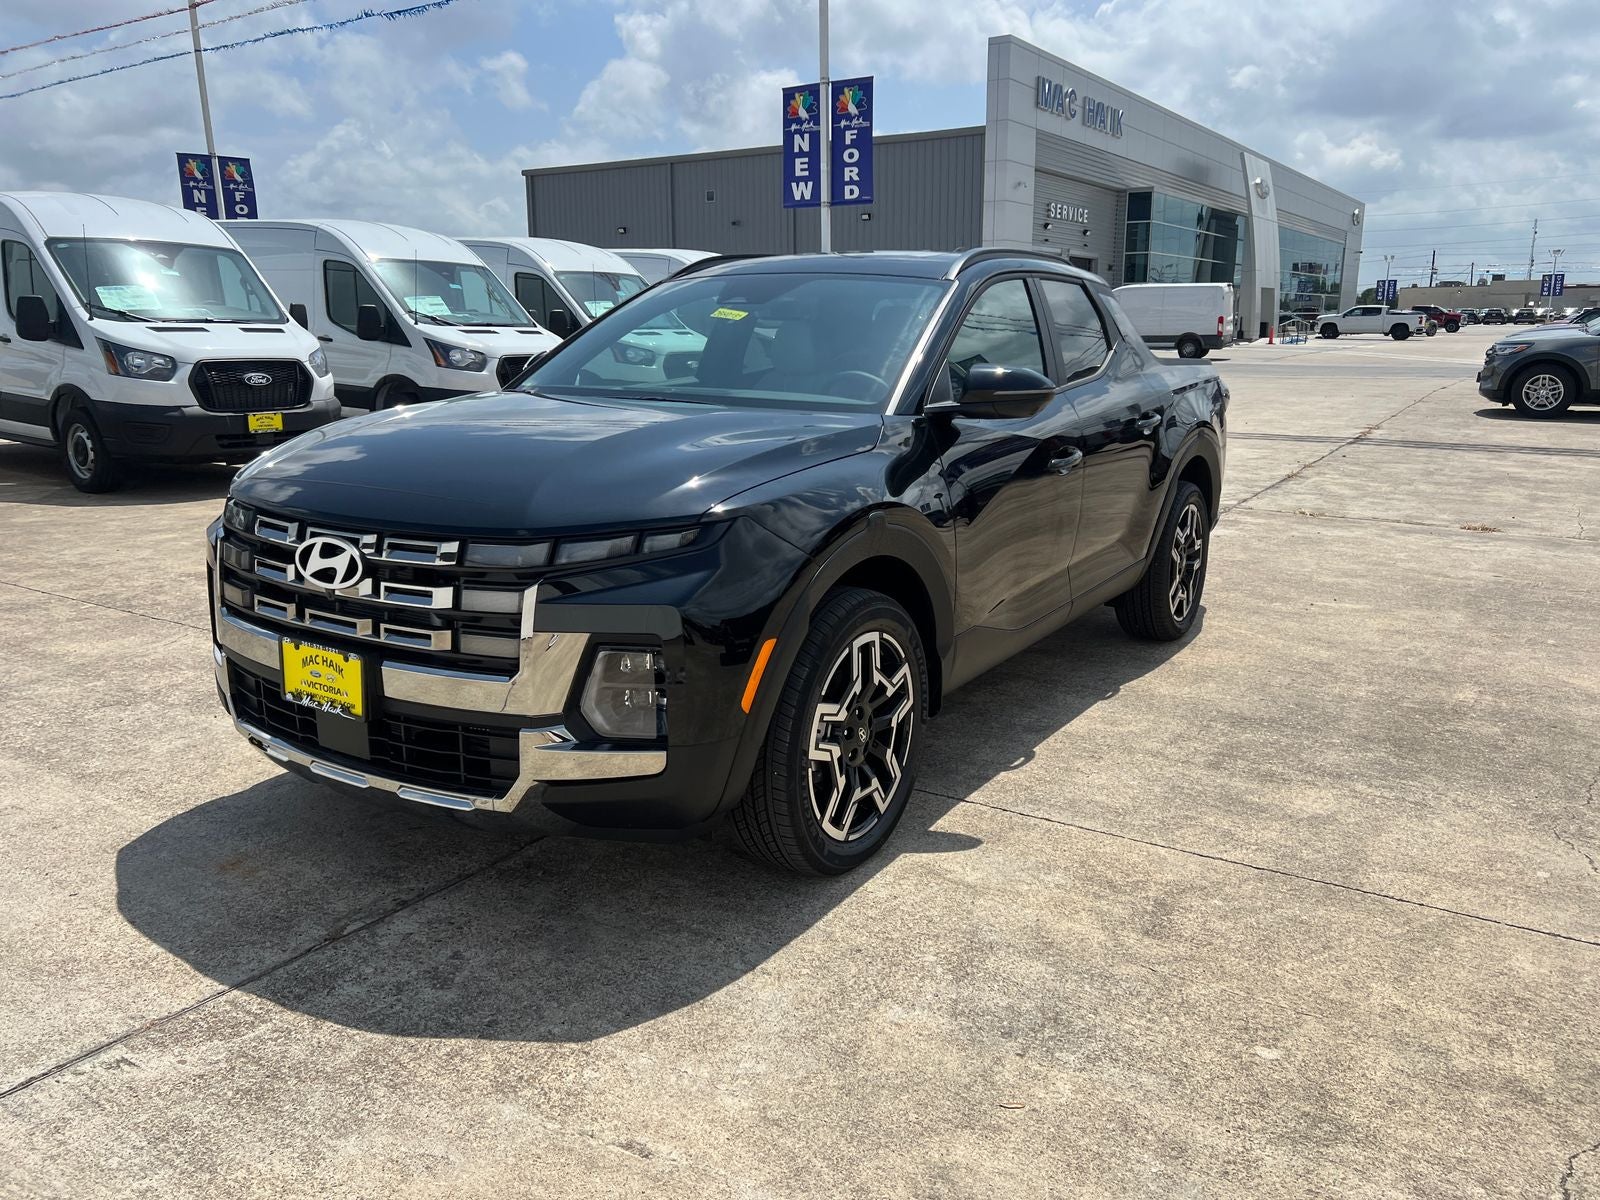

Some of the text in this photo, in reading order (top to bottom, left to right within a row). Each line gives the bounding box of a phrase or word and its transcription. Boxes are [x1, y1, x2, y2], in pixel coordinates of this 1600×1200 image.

[1036, 76, 1124, 139] MAC HAIK
[791, 133, 813, 201] NEW
[842, 129, 860, 200] FORD
[235, 192, 249, 219] FO
[1050, 202, 1088, 223] SERVICE
[302, 655, 344, 679] MAC HAIK
[306, 680, 342, 697] VICTORIA
[300, 695, 319, 709] Mac
